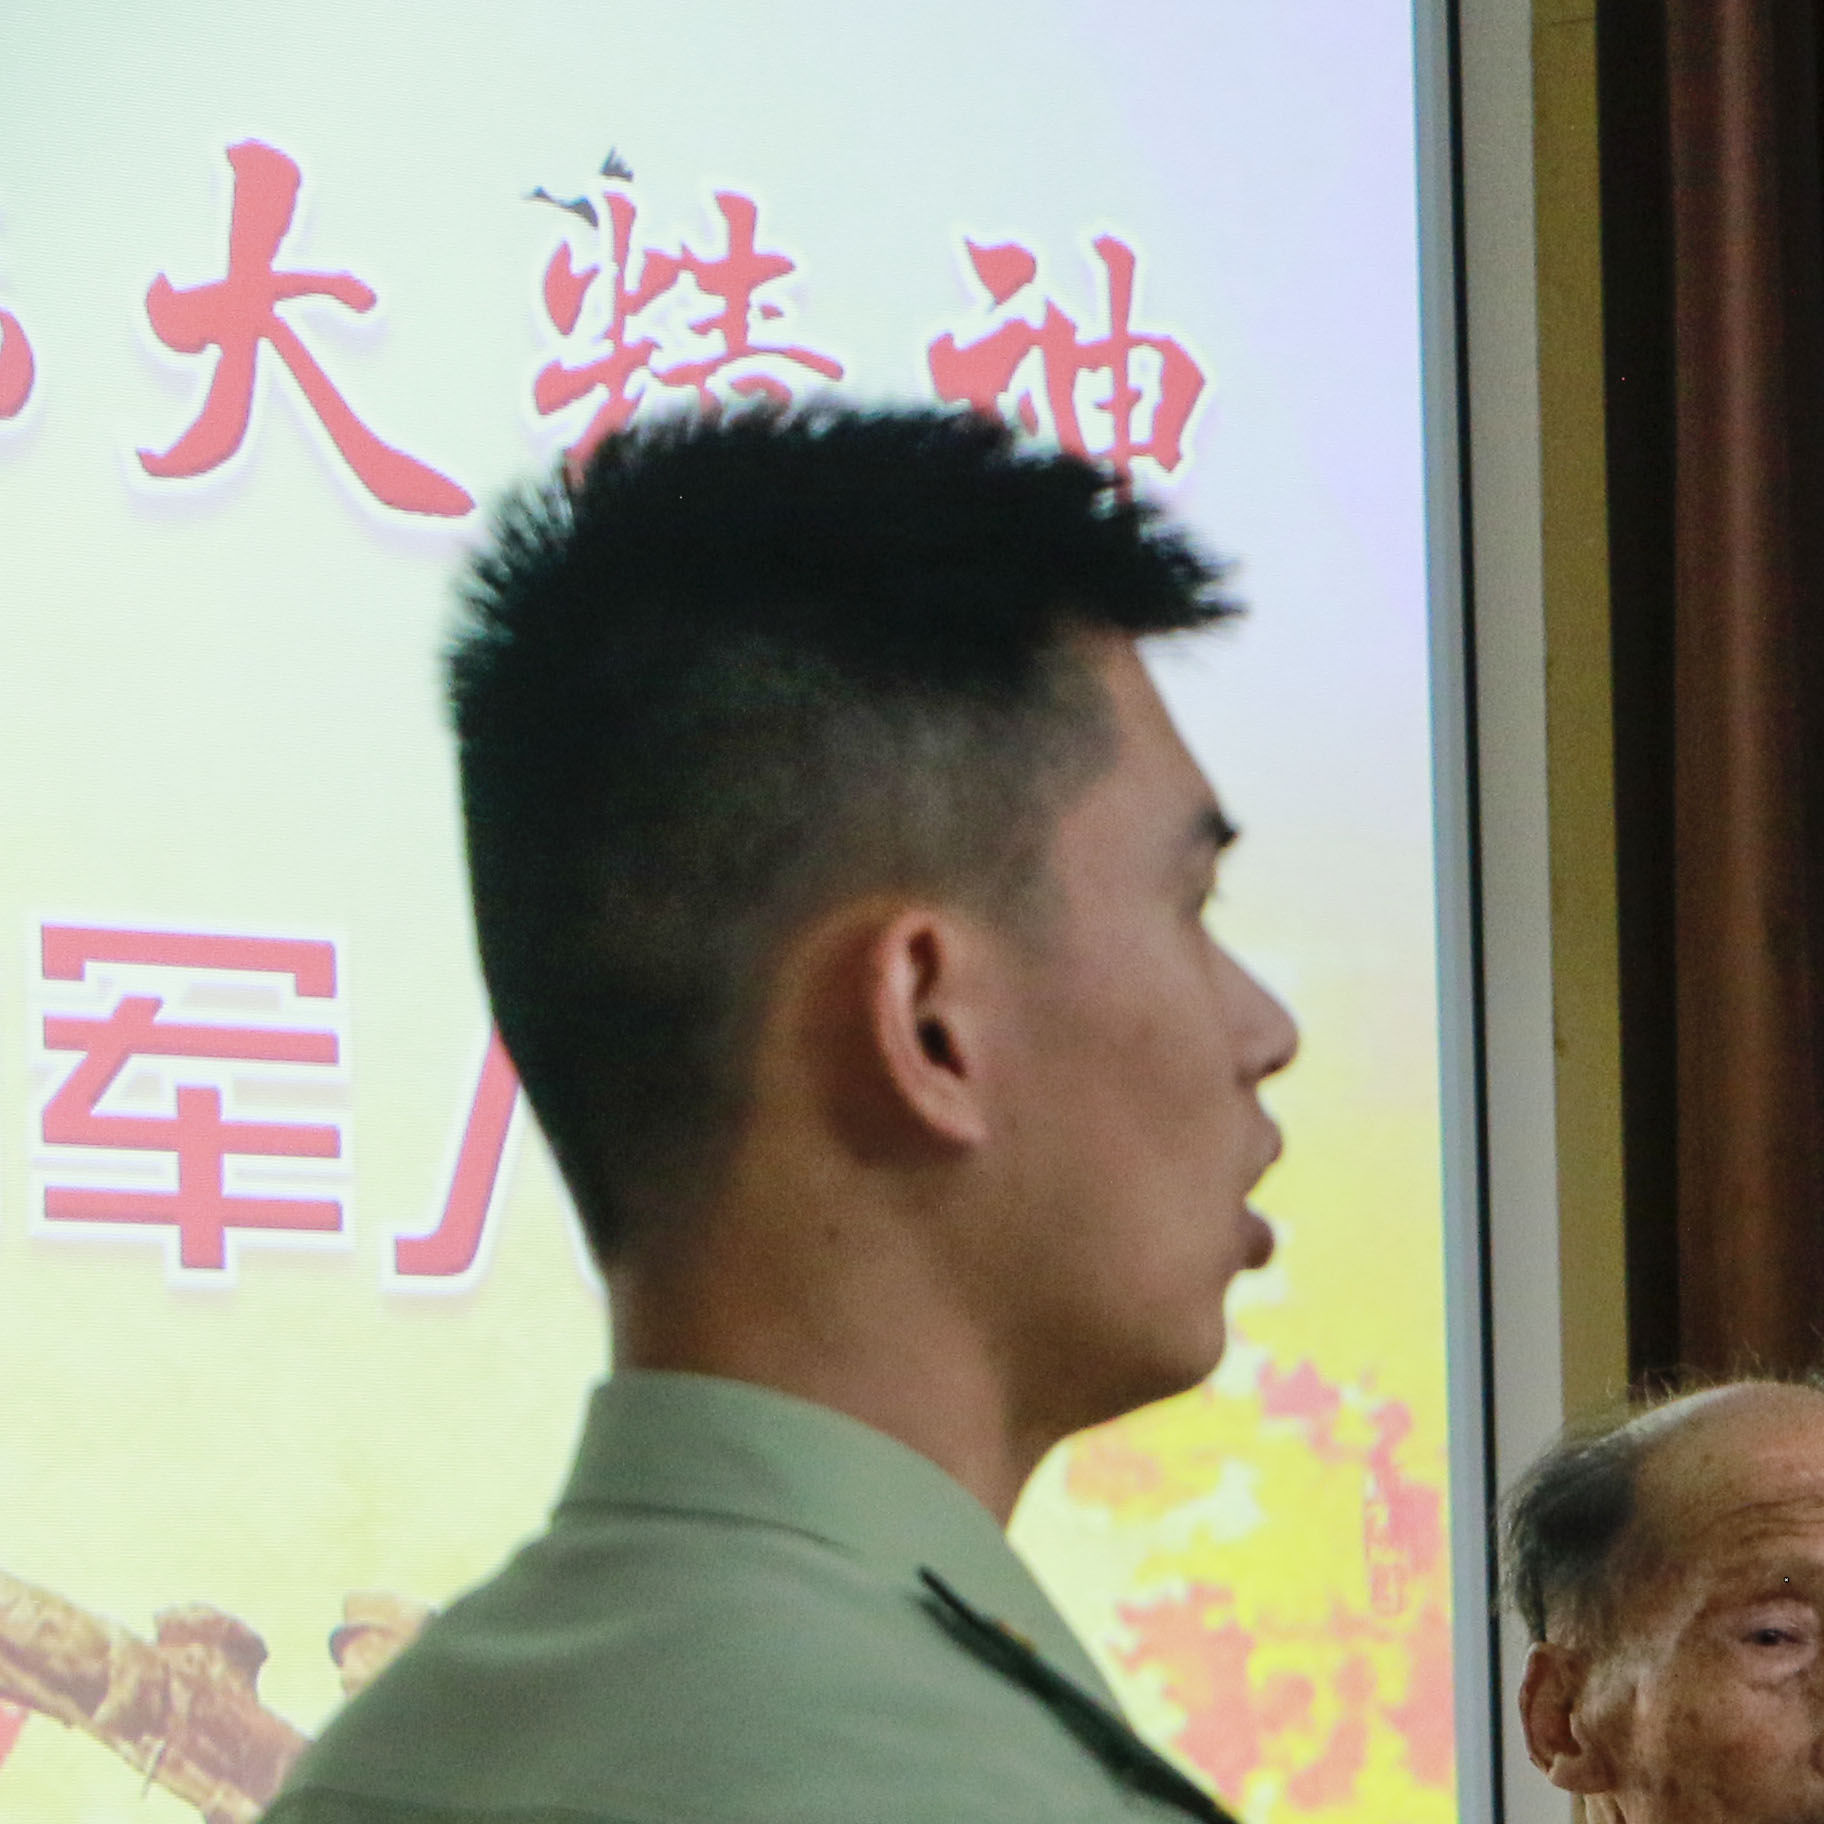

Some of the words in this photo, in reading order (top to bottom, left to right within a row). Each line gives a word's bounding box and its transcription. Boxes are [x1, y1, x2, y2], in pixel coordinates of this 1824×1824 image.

[0, 138, 1206, 516] 大精神
[42, 922, 522, 1276] 军
